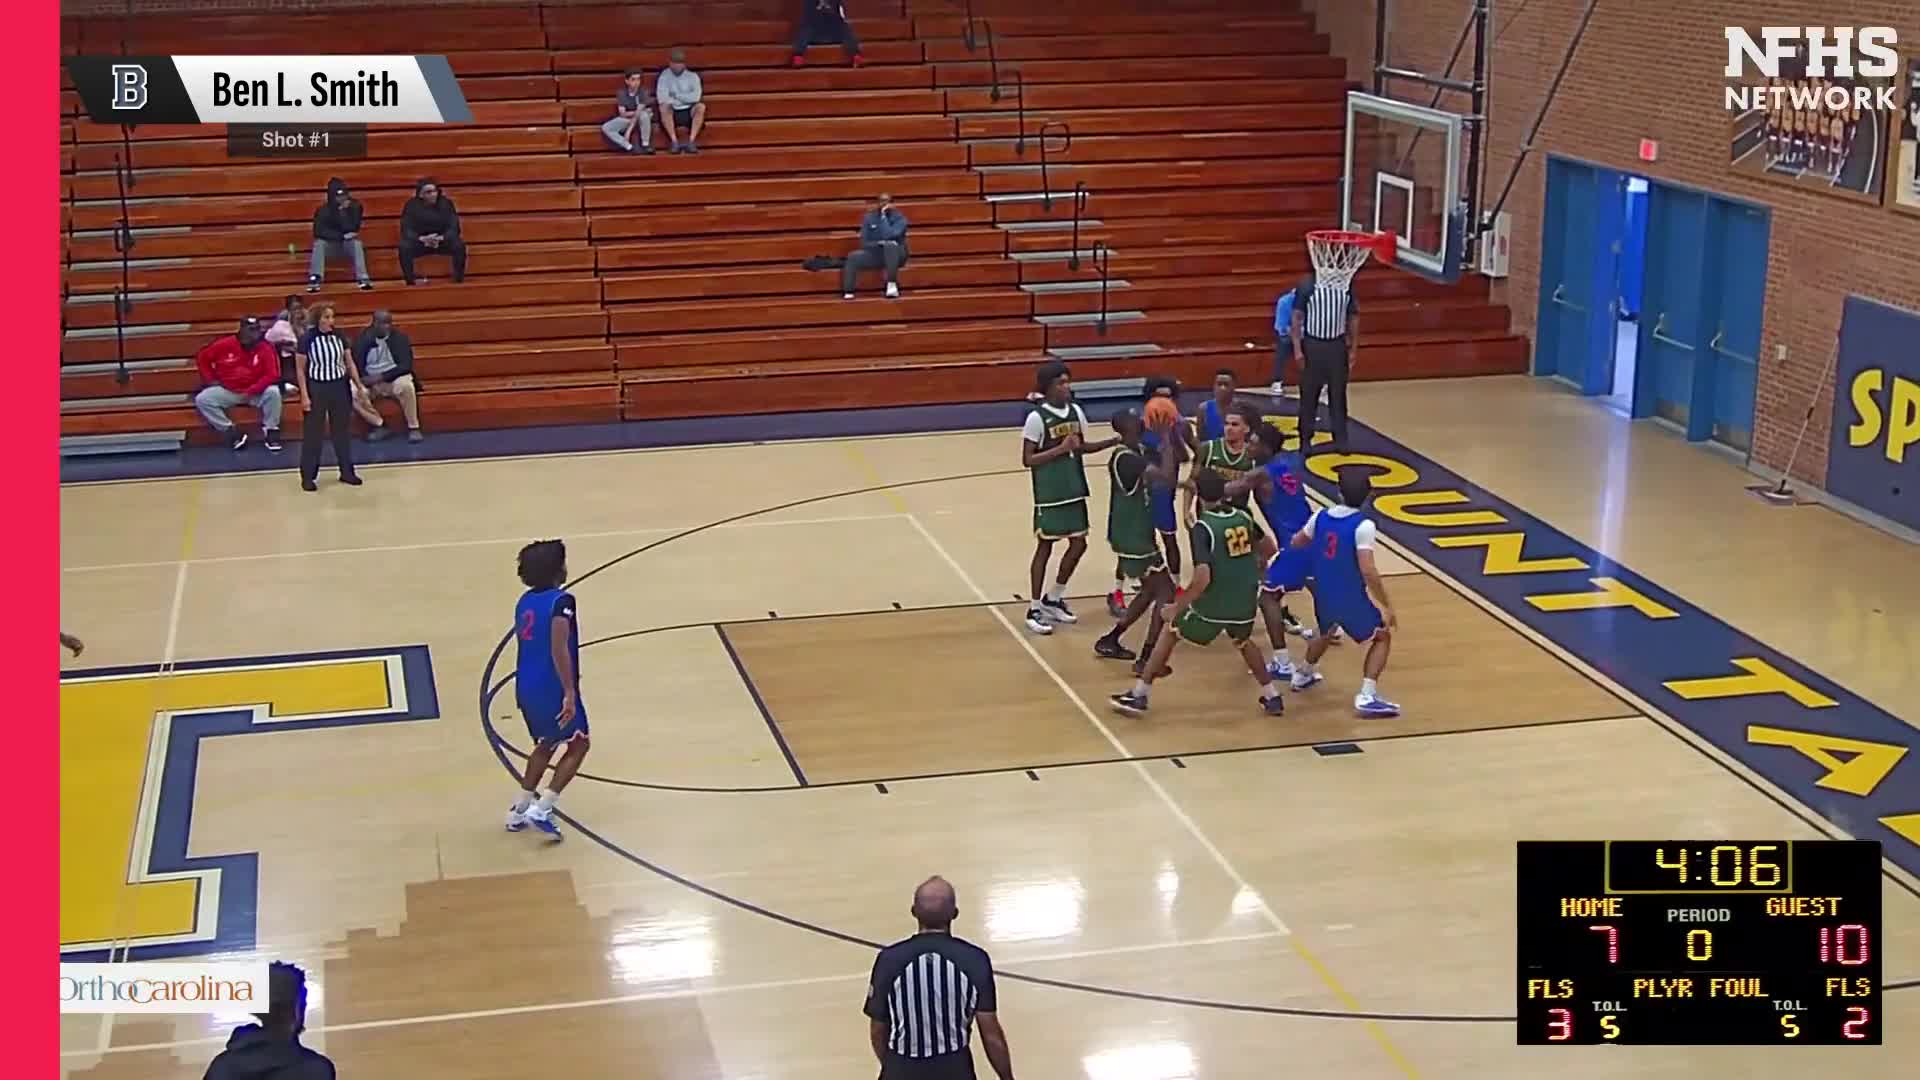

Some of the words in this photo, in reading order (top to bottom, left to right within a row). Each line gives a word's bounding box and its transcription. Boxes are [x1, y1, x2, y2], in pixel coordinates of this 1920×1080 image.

[1224, 525, 1252, 557] 22
[1324, 531, 1339, 560] 3
[521, 608, 536, 641] 2
